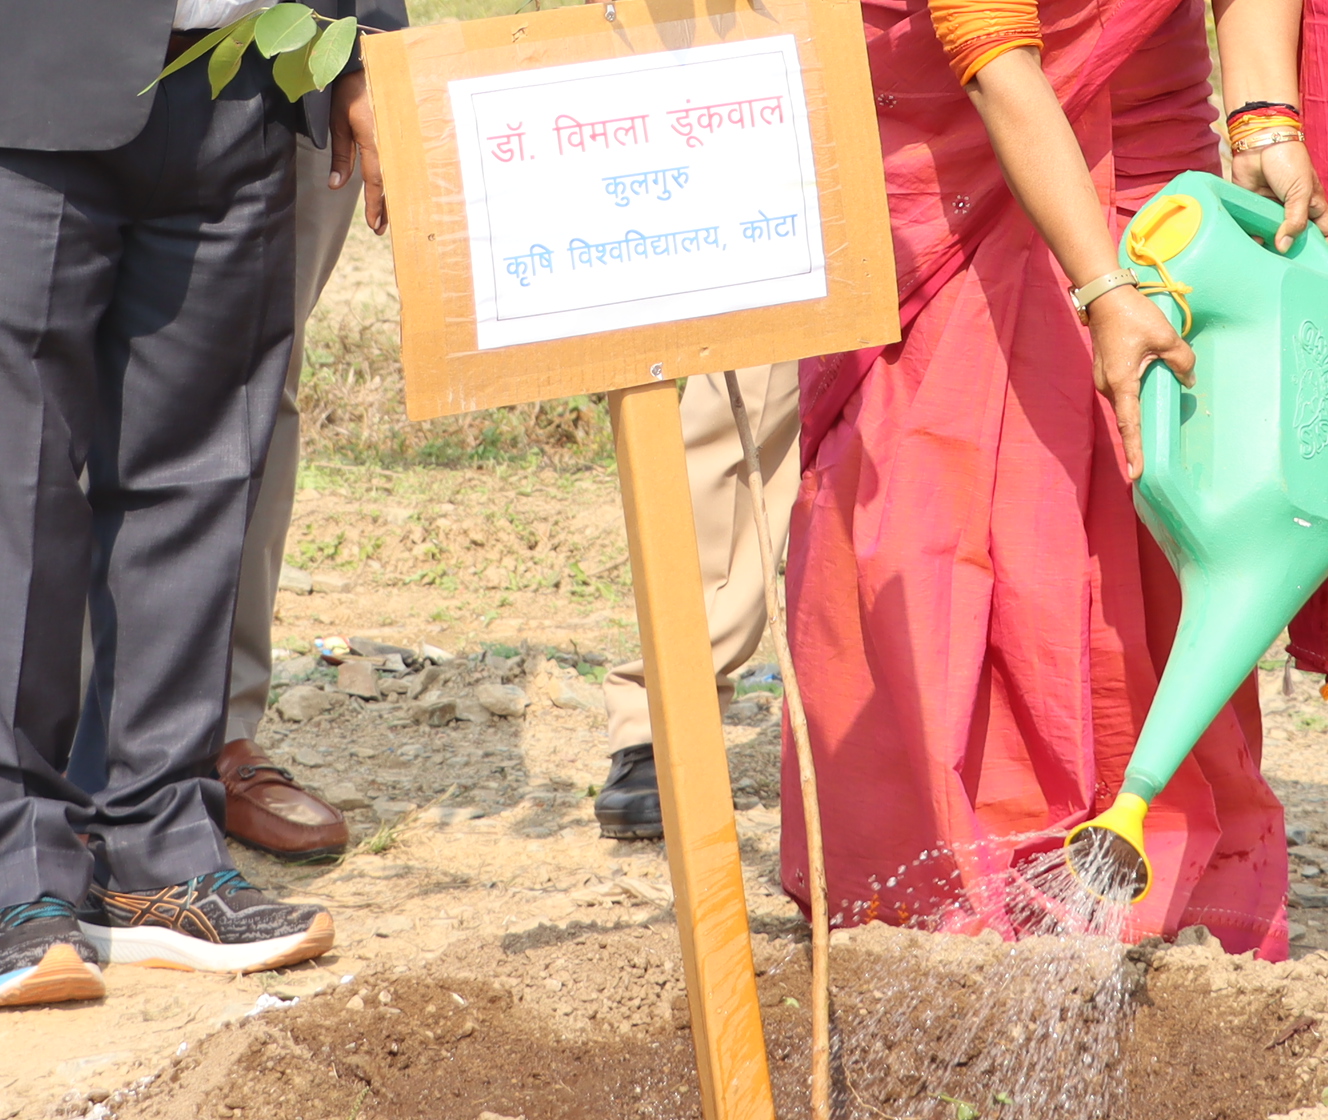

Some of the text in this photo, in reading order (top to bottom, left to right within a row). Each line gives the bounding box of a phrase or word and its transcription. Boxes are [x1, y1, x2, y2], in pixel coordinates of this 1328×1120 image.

[486, 93, 786, 164] डॉ. विमला डूंकवाल
[601, 164, 690, 208] कुलगुरु
[503, 211, 799, 287] कृषि विश्वविद्यालय, कोटा
